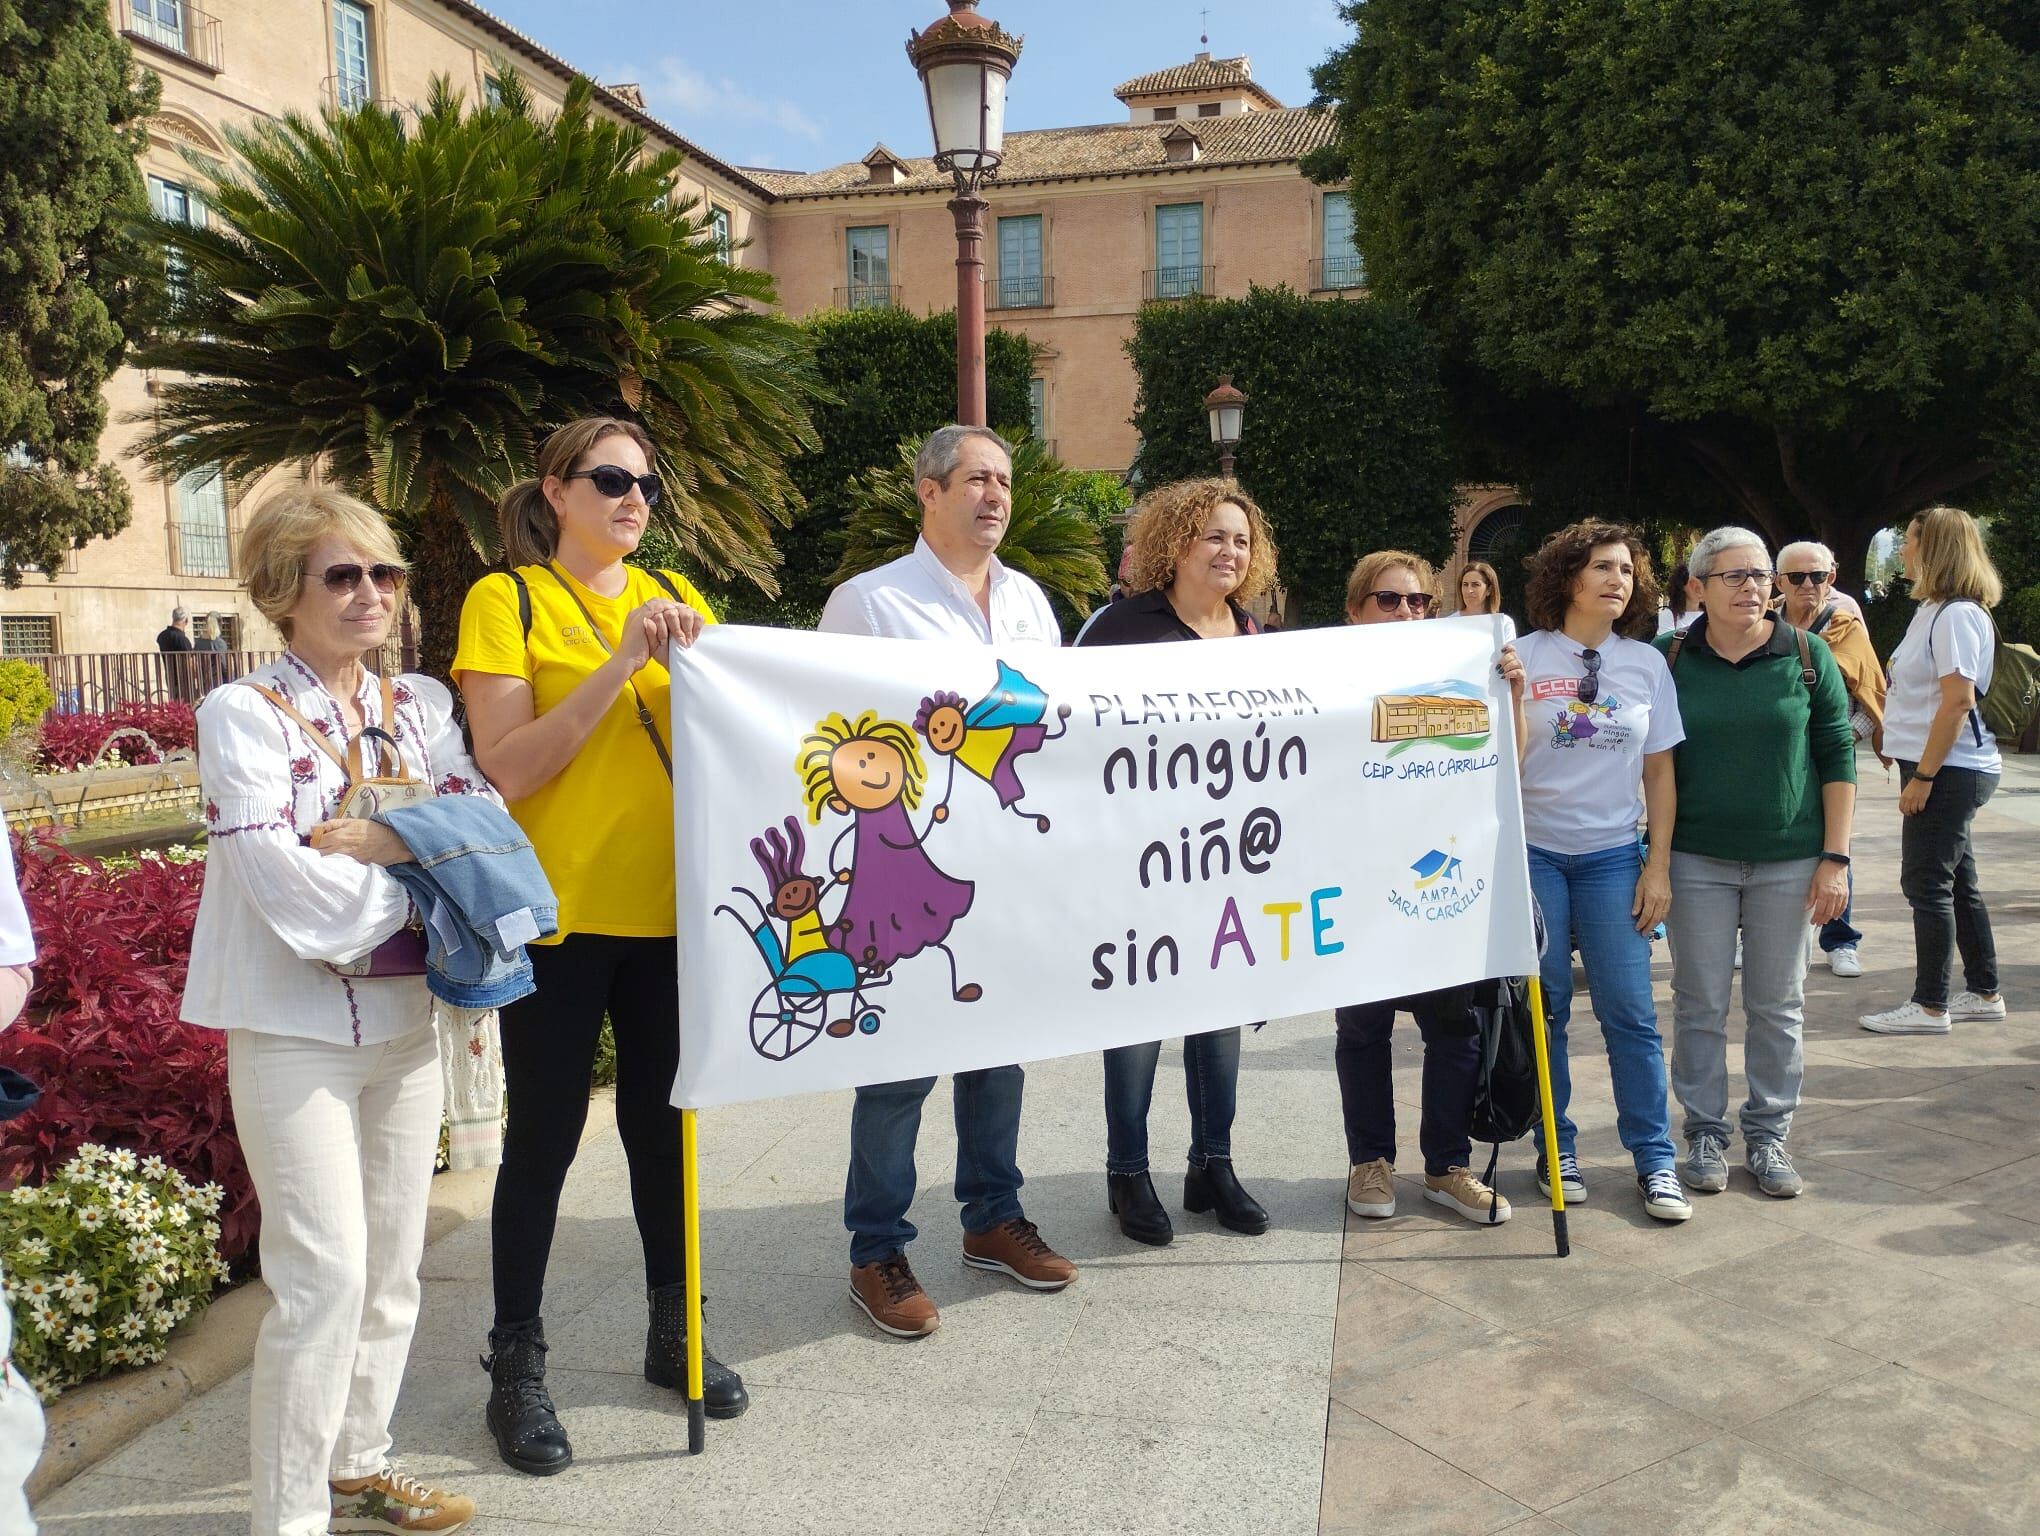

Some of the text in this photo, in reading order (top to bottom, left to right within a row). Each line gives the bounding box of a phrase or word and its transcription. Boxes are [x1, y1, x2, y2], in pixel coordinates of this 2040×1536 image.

[1089, 687, 1319, 727] PLATAFORMA
[1535, 679, 1582, 694] CCO
[1103, 721, 1307, 800] ningún
[1362, 754, 1499, 780] CEIP JARA CARRILLO
[1139, 807, 1282, 888] niñ@
[1388, 878, 1485, 921] JARA CARRILLO
[1420, 886, 1459, 902] AMPA
[1091, 886, 1345, 990] sin ATE
